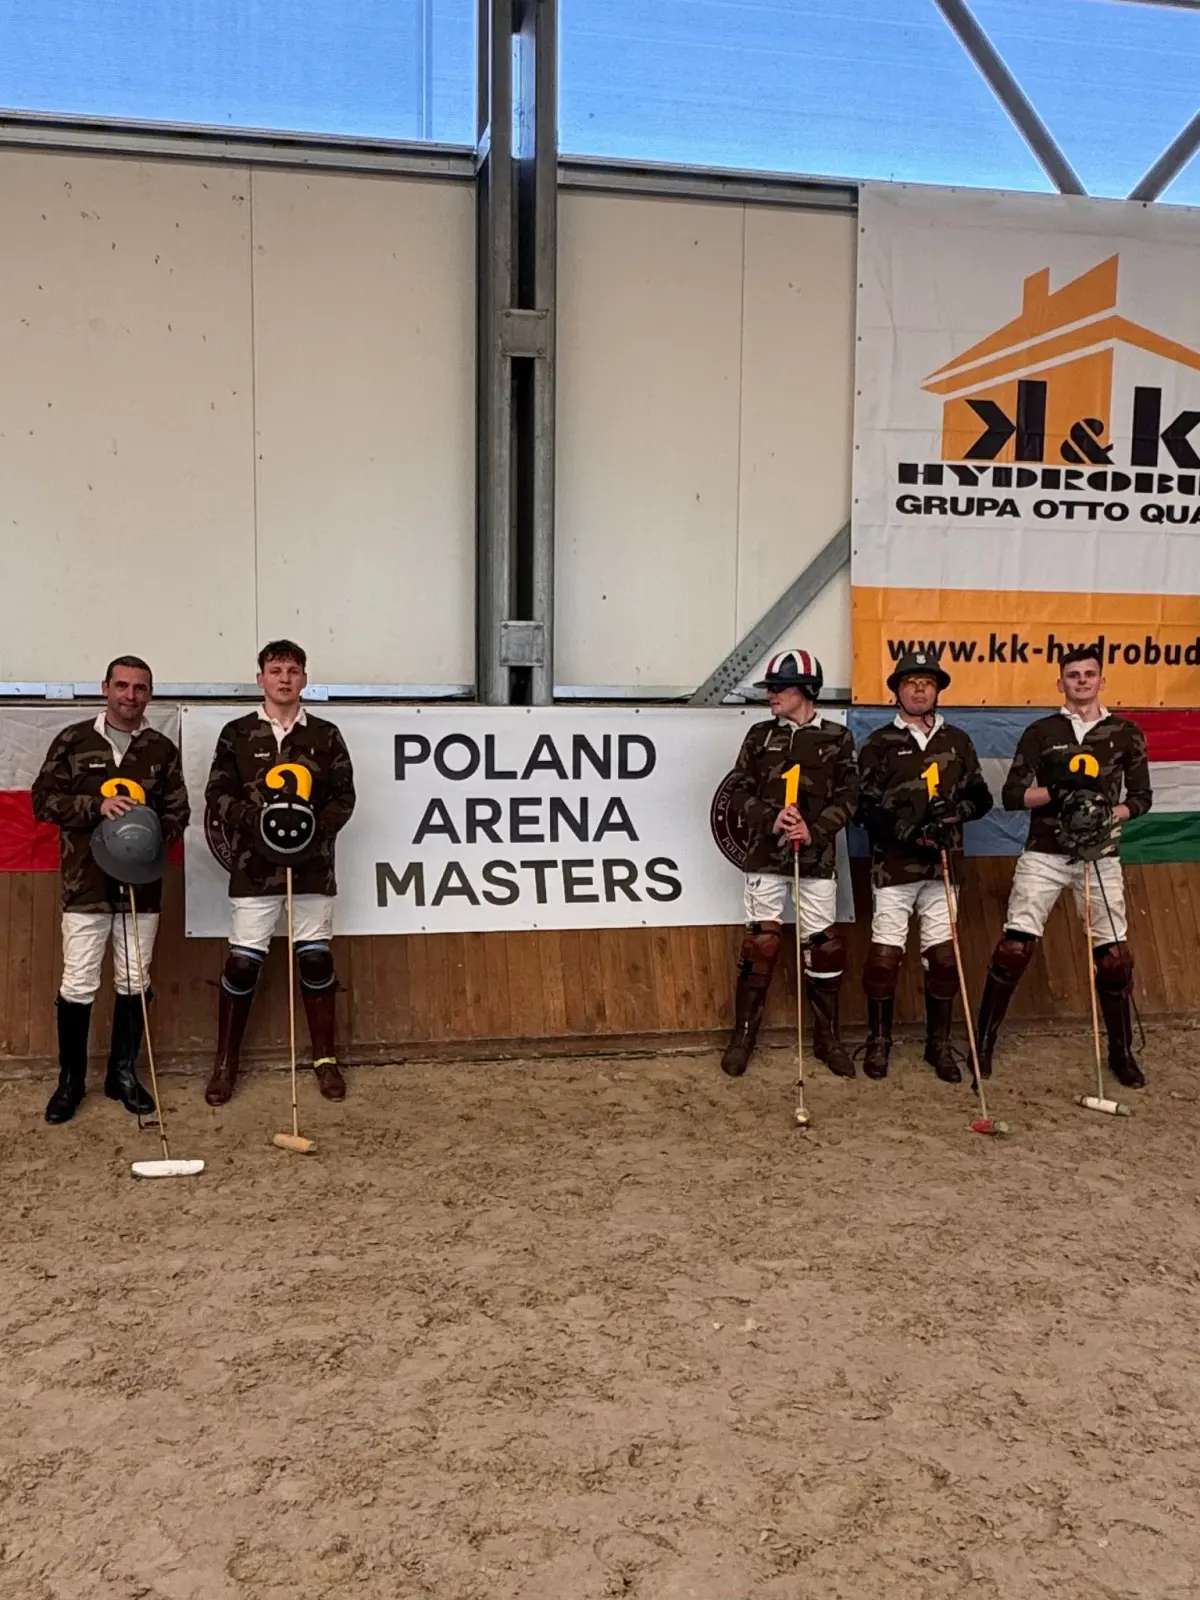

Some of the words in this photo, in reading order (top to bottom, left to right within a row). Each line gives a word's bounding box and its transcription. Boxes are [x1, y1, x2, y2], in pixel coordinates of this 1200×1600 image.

[895, 494, 1021, 518] GRUPA
[1032, 500, 1129, 522] OTTO
[887, 633, 1200, 666] www.kk-hdrobud
[394, 733, 656, 781] POLAND
[781, 763, 800, 810] 1
[920, 762, 940, 803] 1
[411, 796, 640, 844] ARENA
[375, 857, 682, 907] MASTERS
